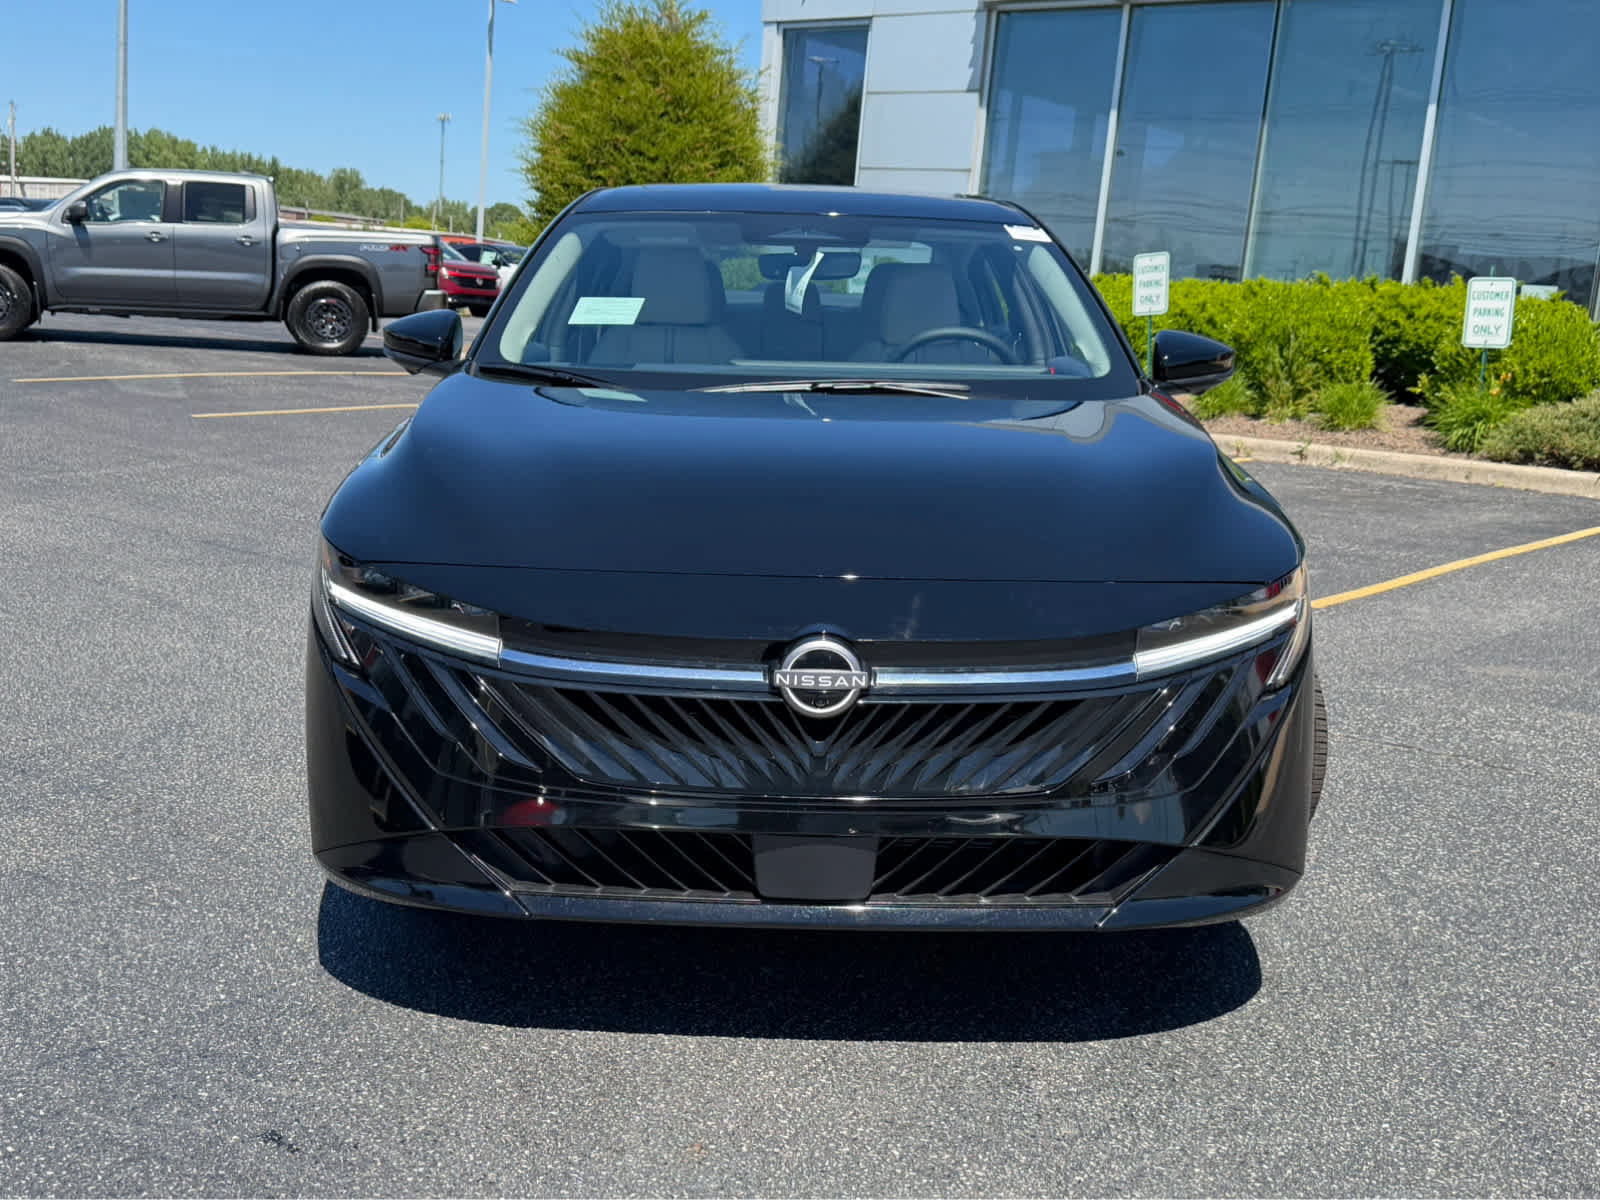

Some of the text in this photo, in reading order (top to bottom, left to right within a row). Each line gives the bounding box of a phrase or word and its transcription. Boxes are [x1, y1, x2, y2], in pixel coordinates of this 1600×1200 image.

[1472, 290, 1510, 301] CUSTOMER
[1473, 307, 1504, 318] PARKING
[1472, 324, 1502, 336] ONLY
[775, 673, 865, 687] NISSAN
